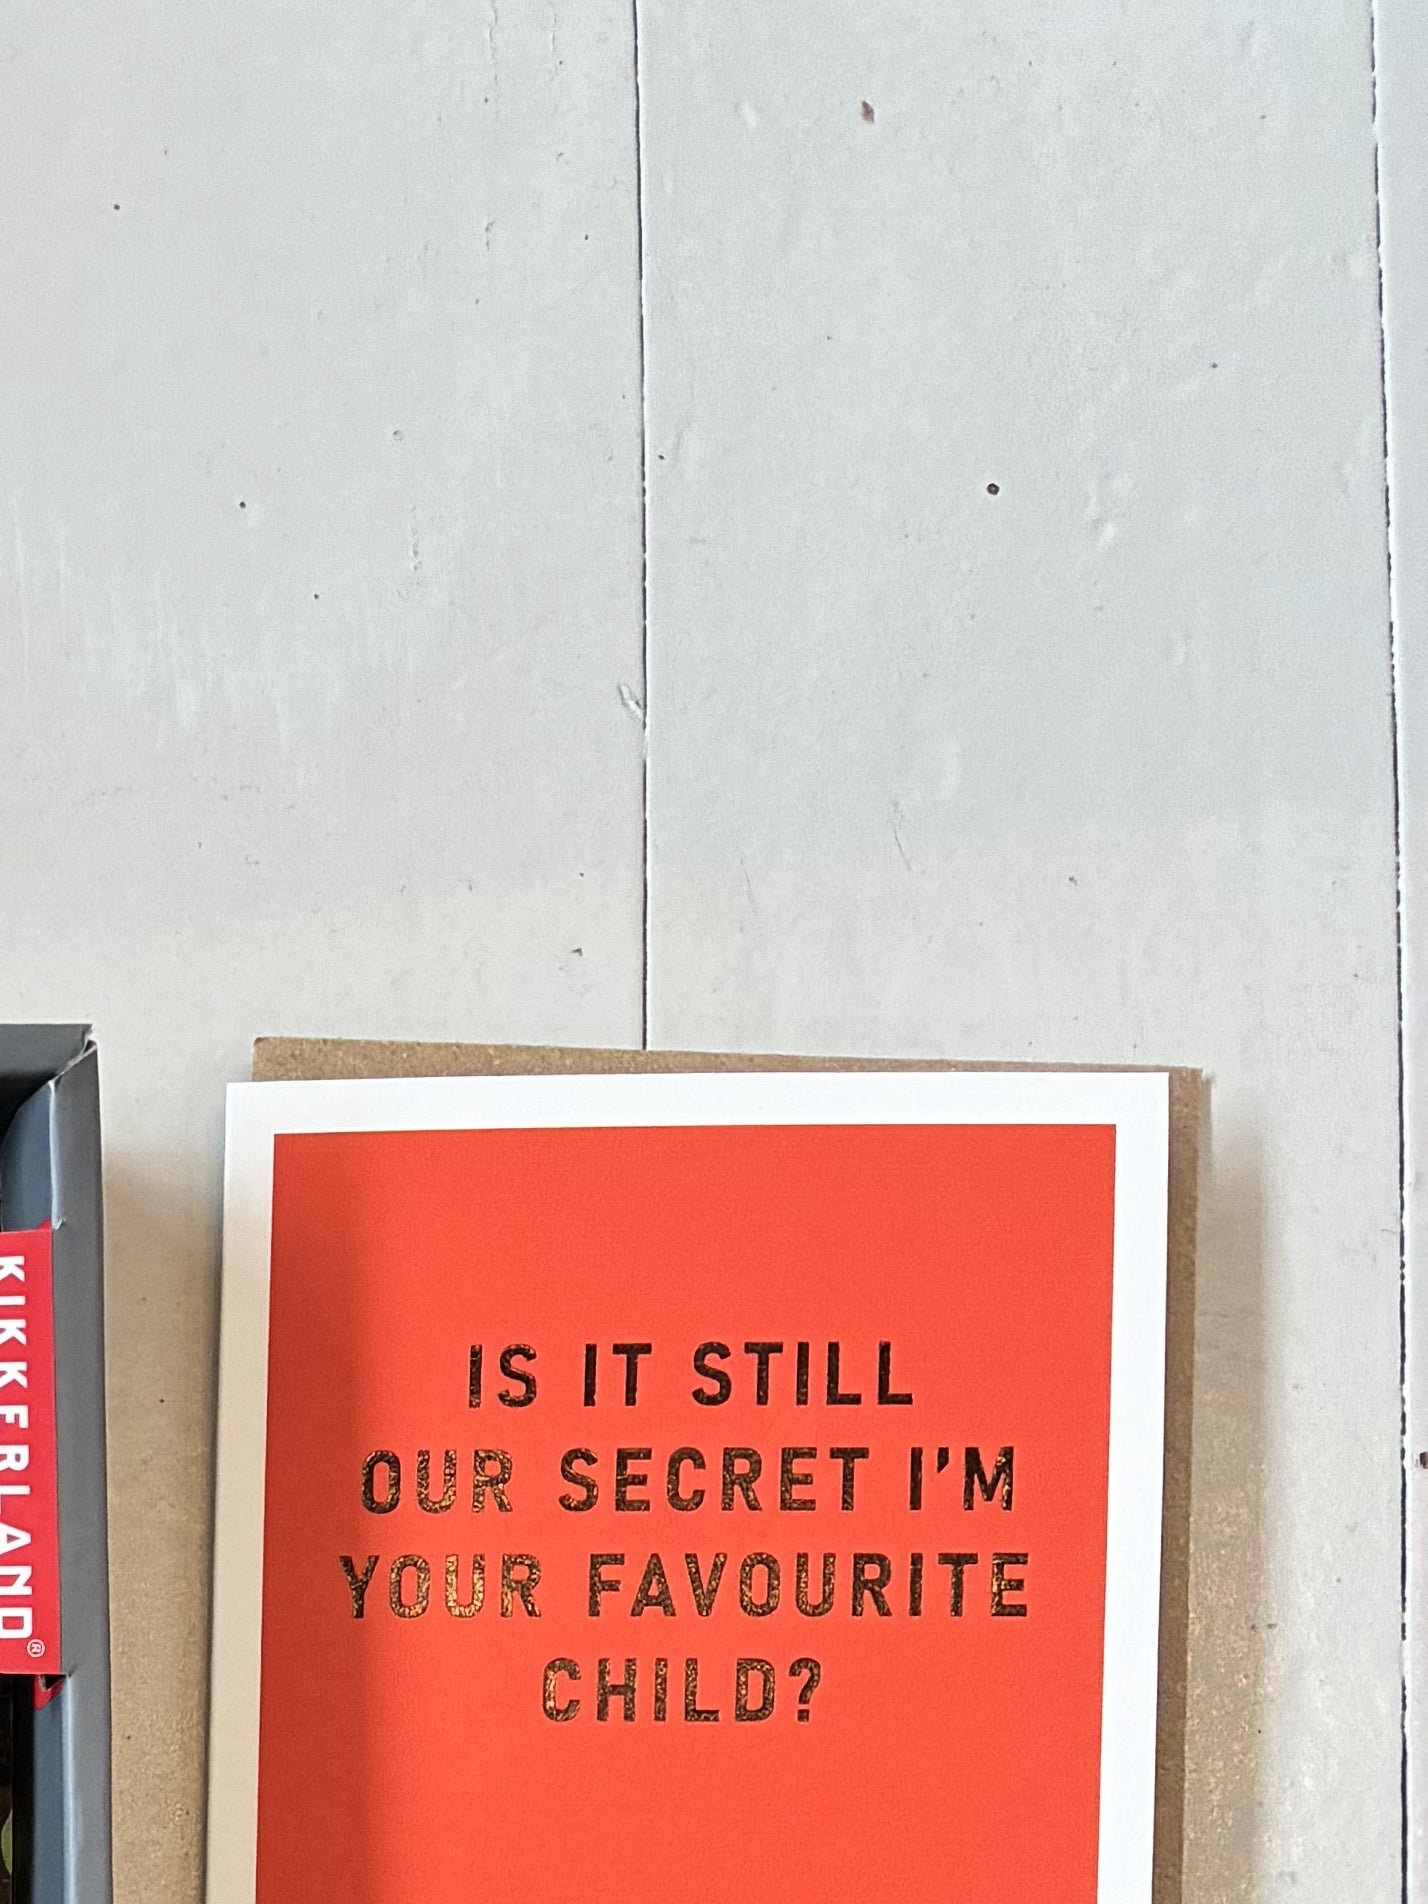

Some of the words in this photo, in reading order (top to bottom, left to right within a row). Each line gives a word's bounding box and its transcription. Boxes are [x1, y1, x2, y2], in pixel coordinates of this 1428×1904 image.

[469, 1344, 536, 1408] IS
[584, 1343, 652, 1406] IT
[692, 1342, 913, 1406] STILL
[361, 1450, 512, 1514] OUR
[559, 1447, 869, 1512] SECRET
[910, 1447, 1013, 1511] I'M
[339, 1554, 541, 1619] YOUR
[589, 1552, 1028, 1617] FAVOURITE
[543, 1658, 820, 1722] CHILD?
